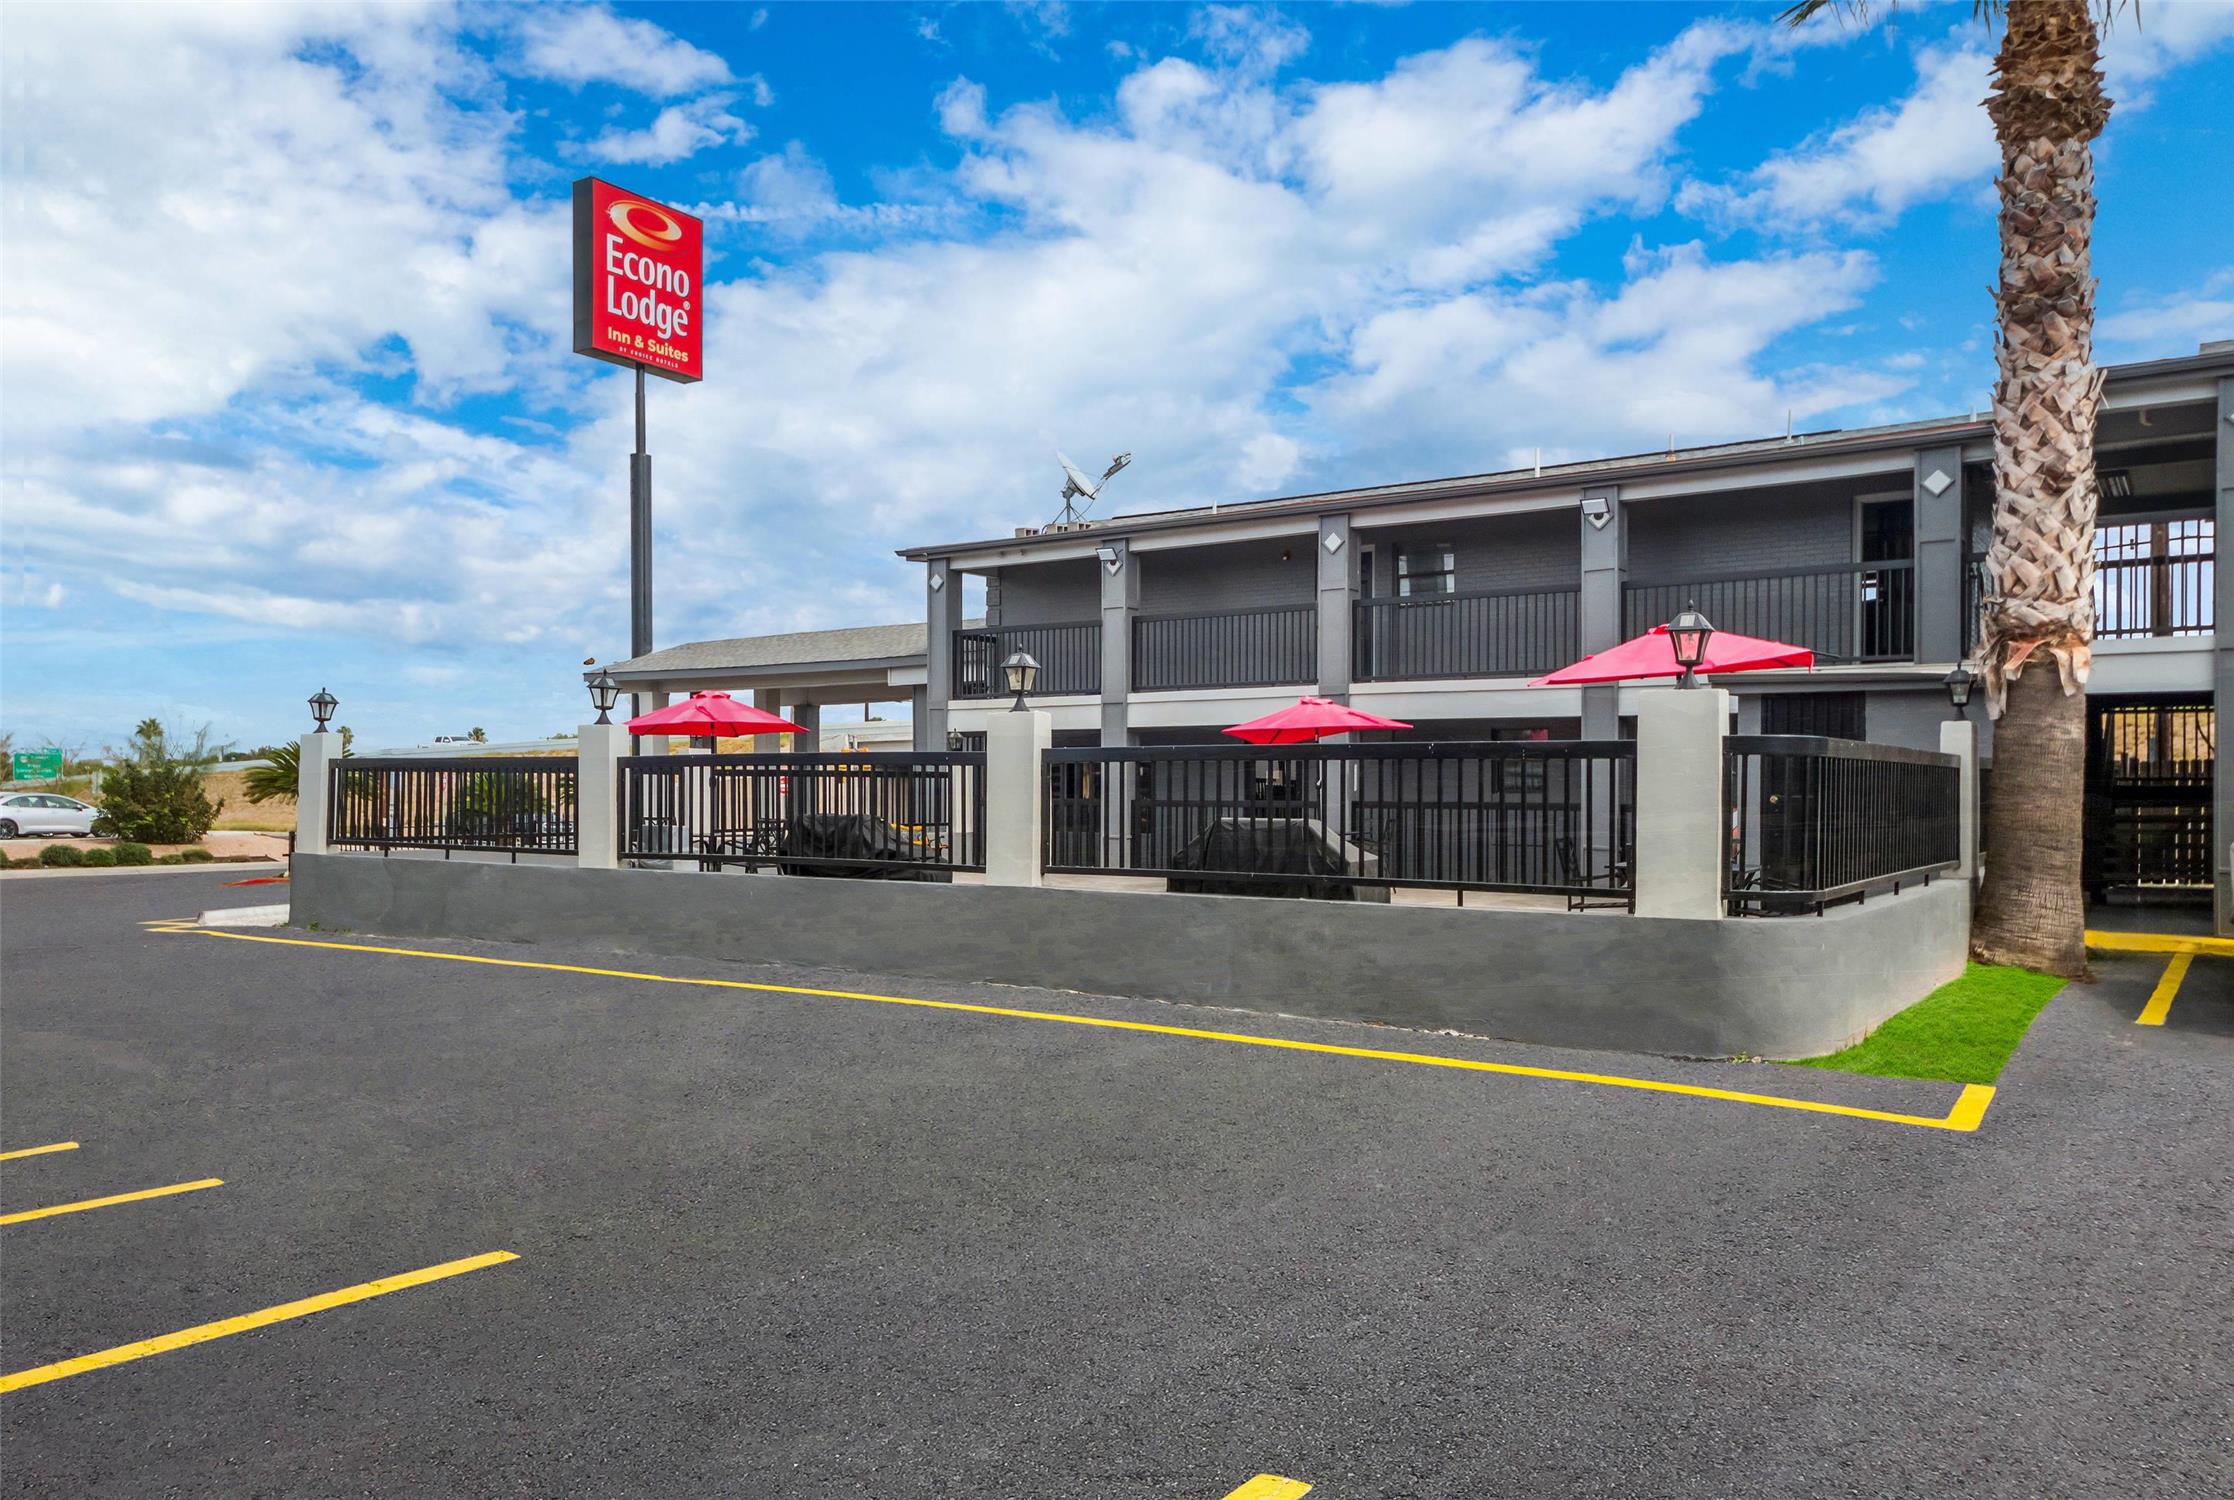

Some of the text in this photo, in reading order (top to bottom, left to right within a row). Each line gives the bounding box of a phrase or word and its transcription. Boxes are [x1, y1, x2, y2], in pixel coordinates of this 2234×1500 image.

[606, 233, 690, 297] Econo
[607, 275, 688, 339] Lodge
[607, 326, 689, 362] Inn & Suites
